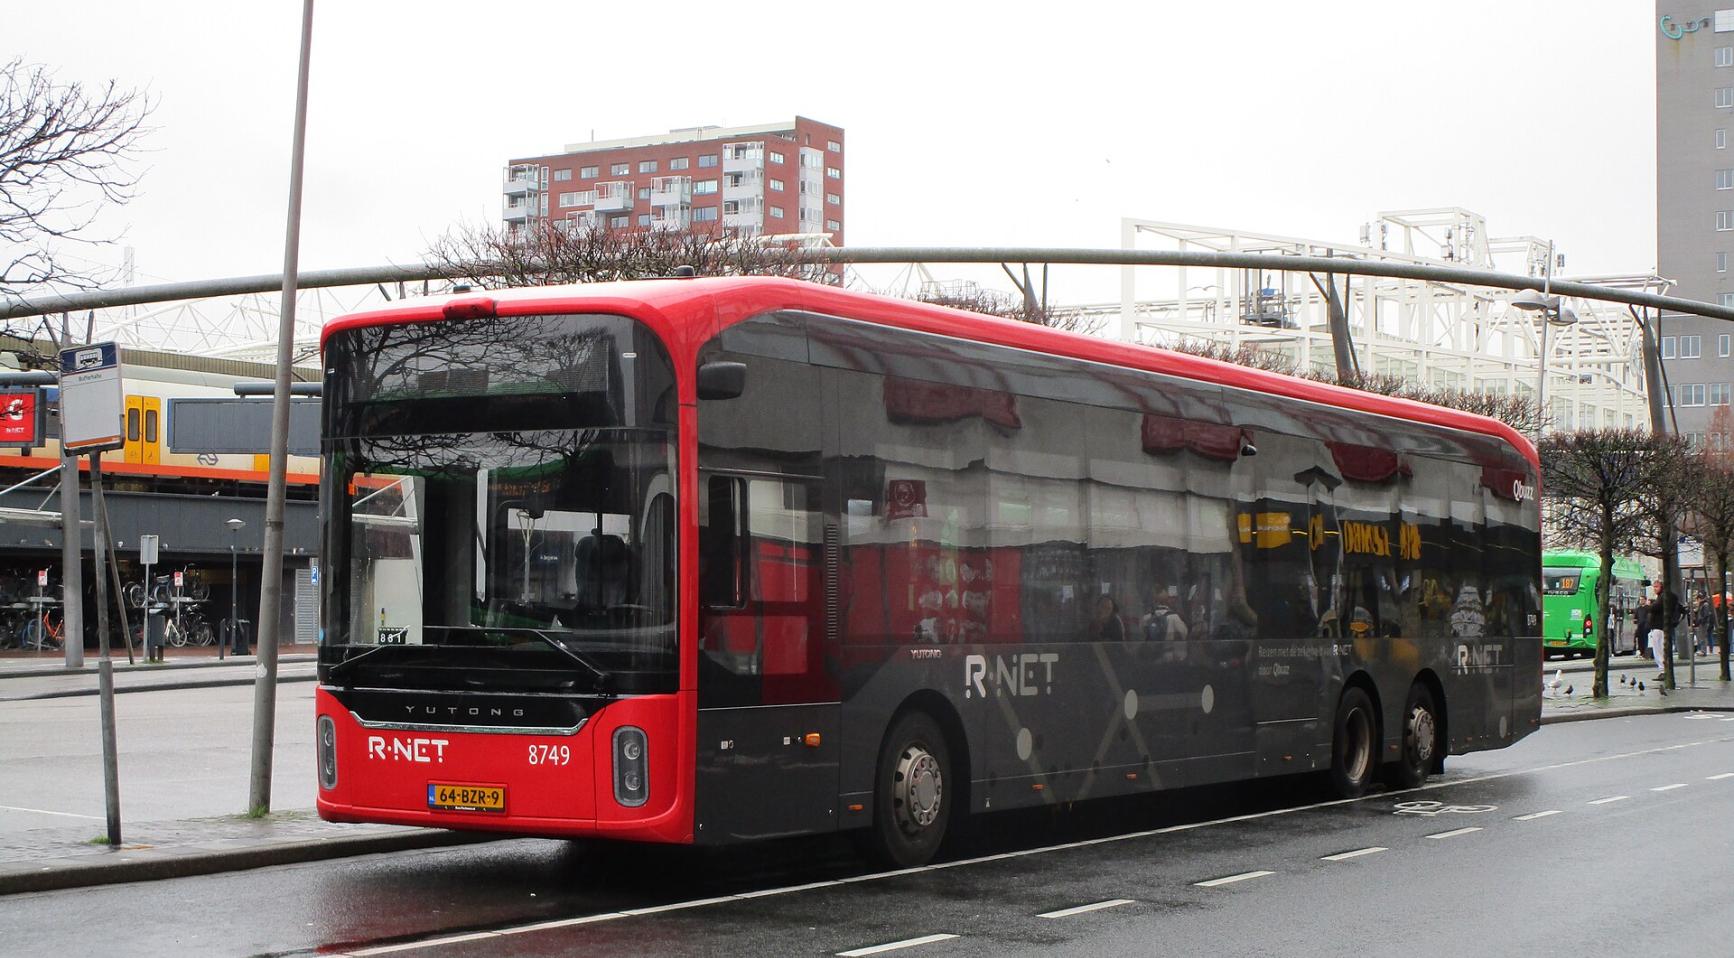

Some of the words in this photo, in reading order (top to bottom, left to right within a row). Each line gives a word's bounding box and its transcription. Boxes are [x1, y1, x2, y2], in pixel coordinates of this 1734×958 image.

[406, 706, 524, 716] YUTONG
[528, 745, 570, 766] 8749
[440, 788, 499, 805] 64-BZR-9
